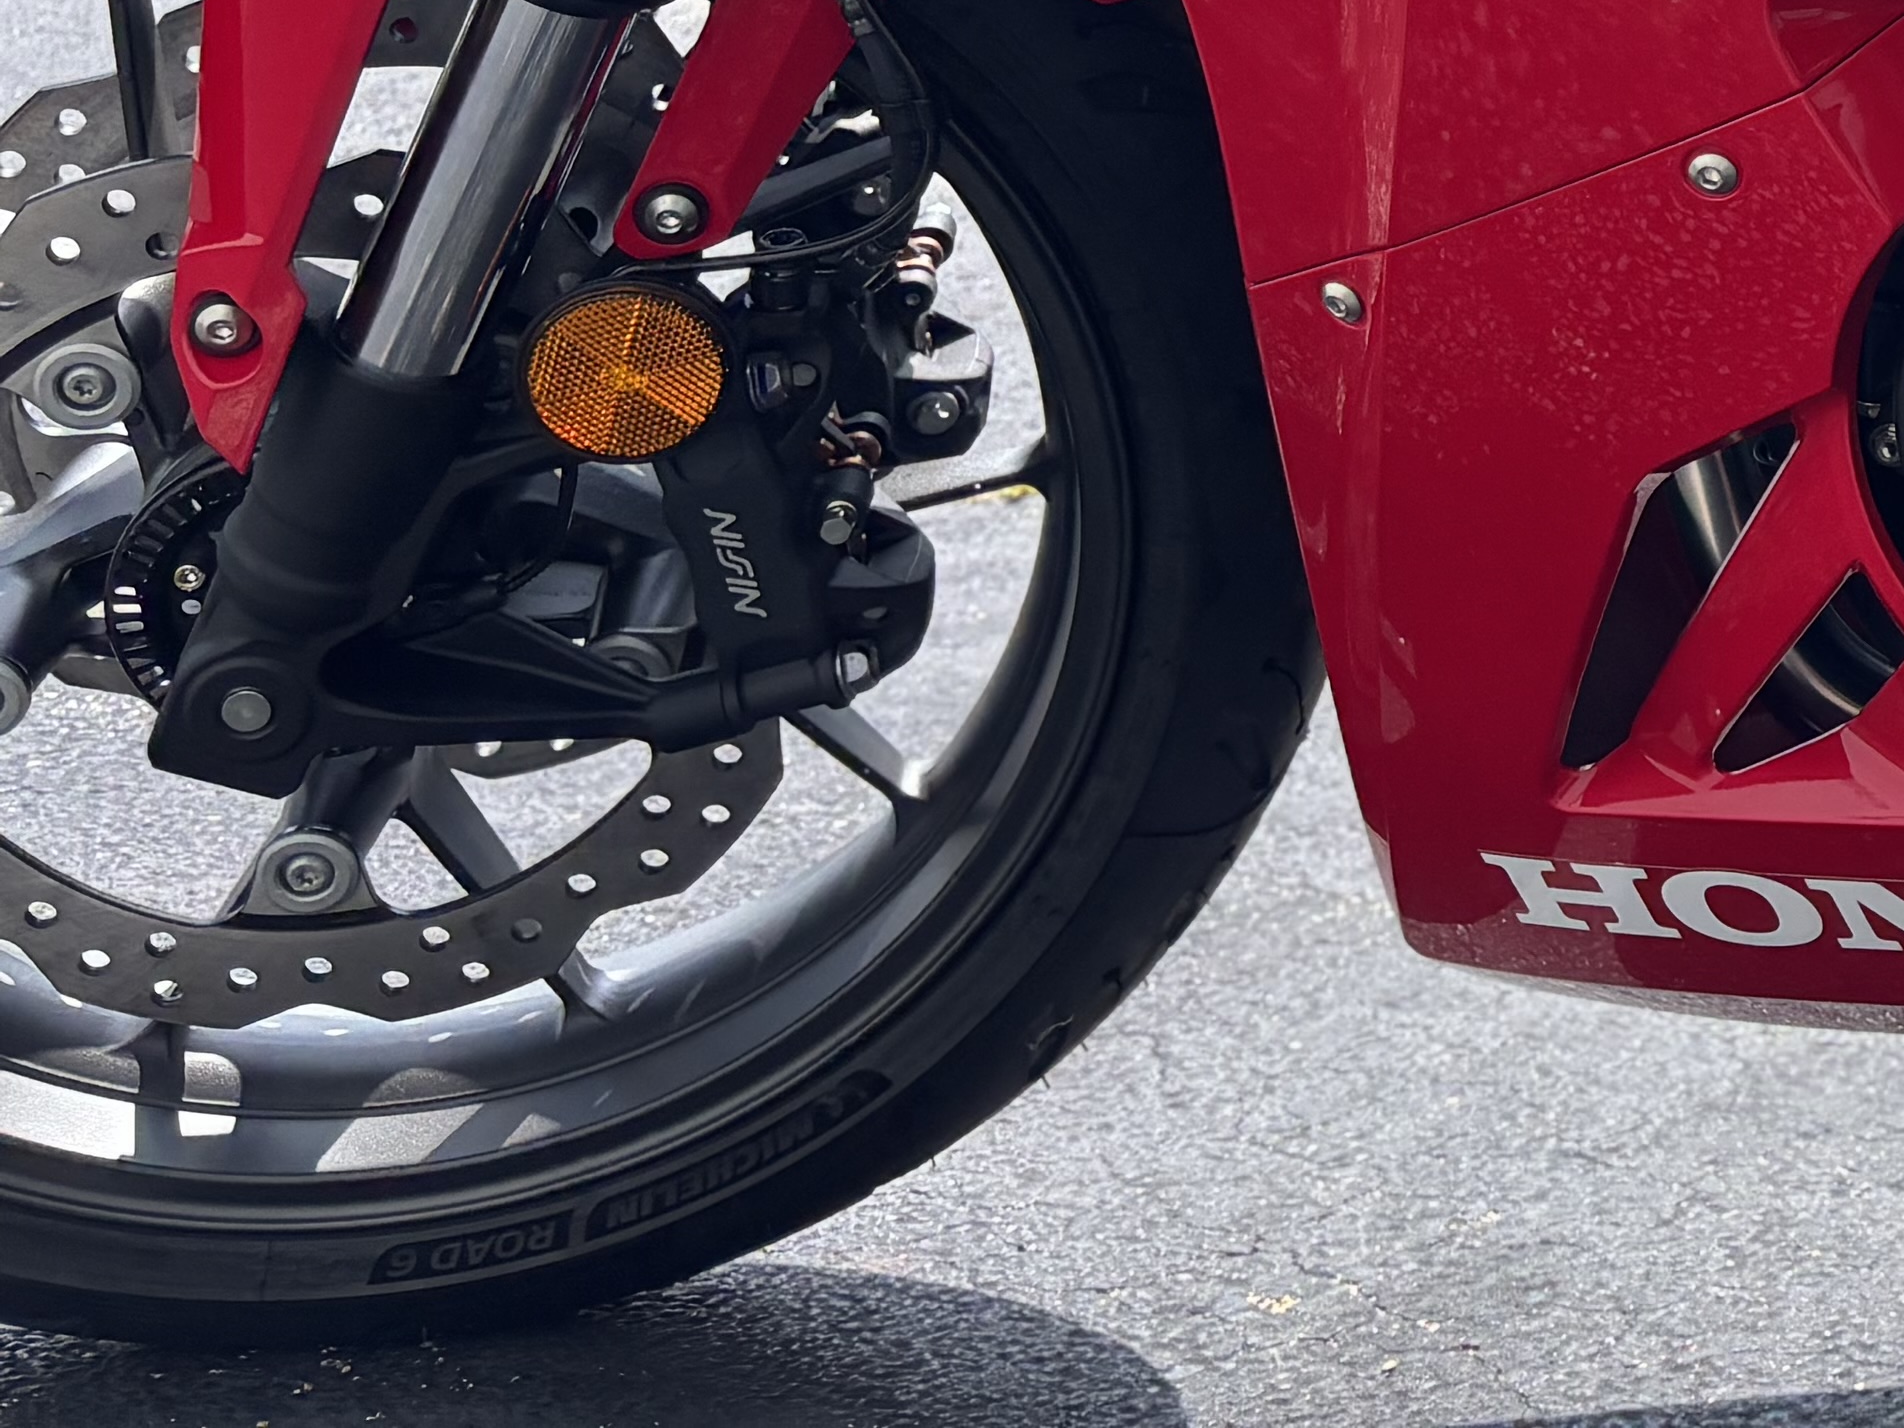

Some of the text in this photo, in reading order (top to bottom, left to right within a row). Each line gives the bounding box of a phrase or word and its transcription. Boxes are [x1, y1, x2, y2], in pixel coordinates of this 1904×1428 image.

[703, 508, 767, 617] NISSIN
[385, 1114, 812, 1278] MICHELIN ROAD 6
